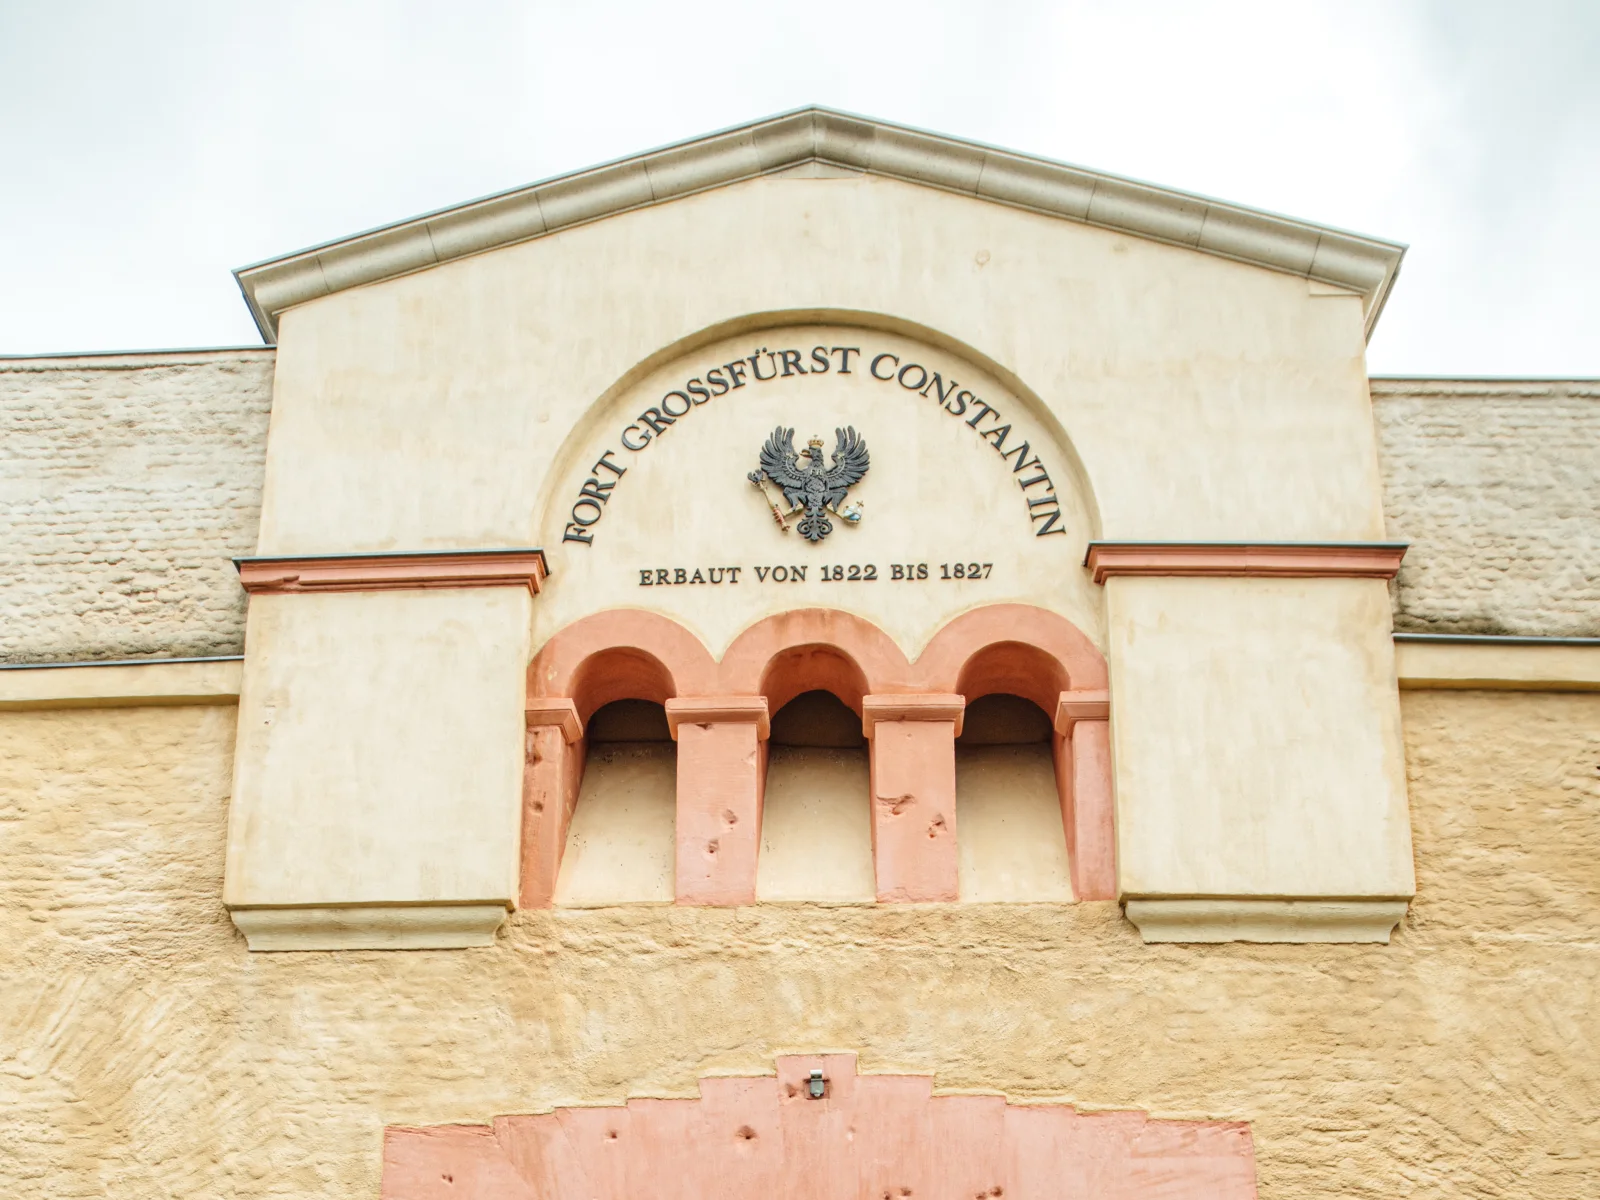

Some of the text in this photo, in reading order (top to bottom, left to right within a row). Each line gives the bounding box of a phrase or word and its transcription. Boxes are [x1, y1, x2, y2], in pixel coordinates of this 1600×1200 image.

[562, 346, 1067, 547] FORT GROSSFÜRST CONSTANTIN
[639, 562, 994, 586] ERBAUT VON 1822 BIS 1827
